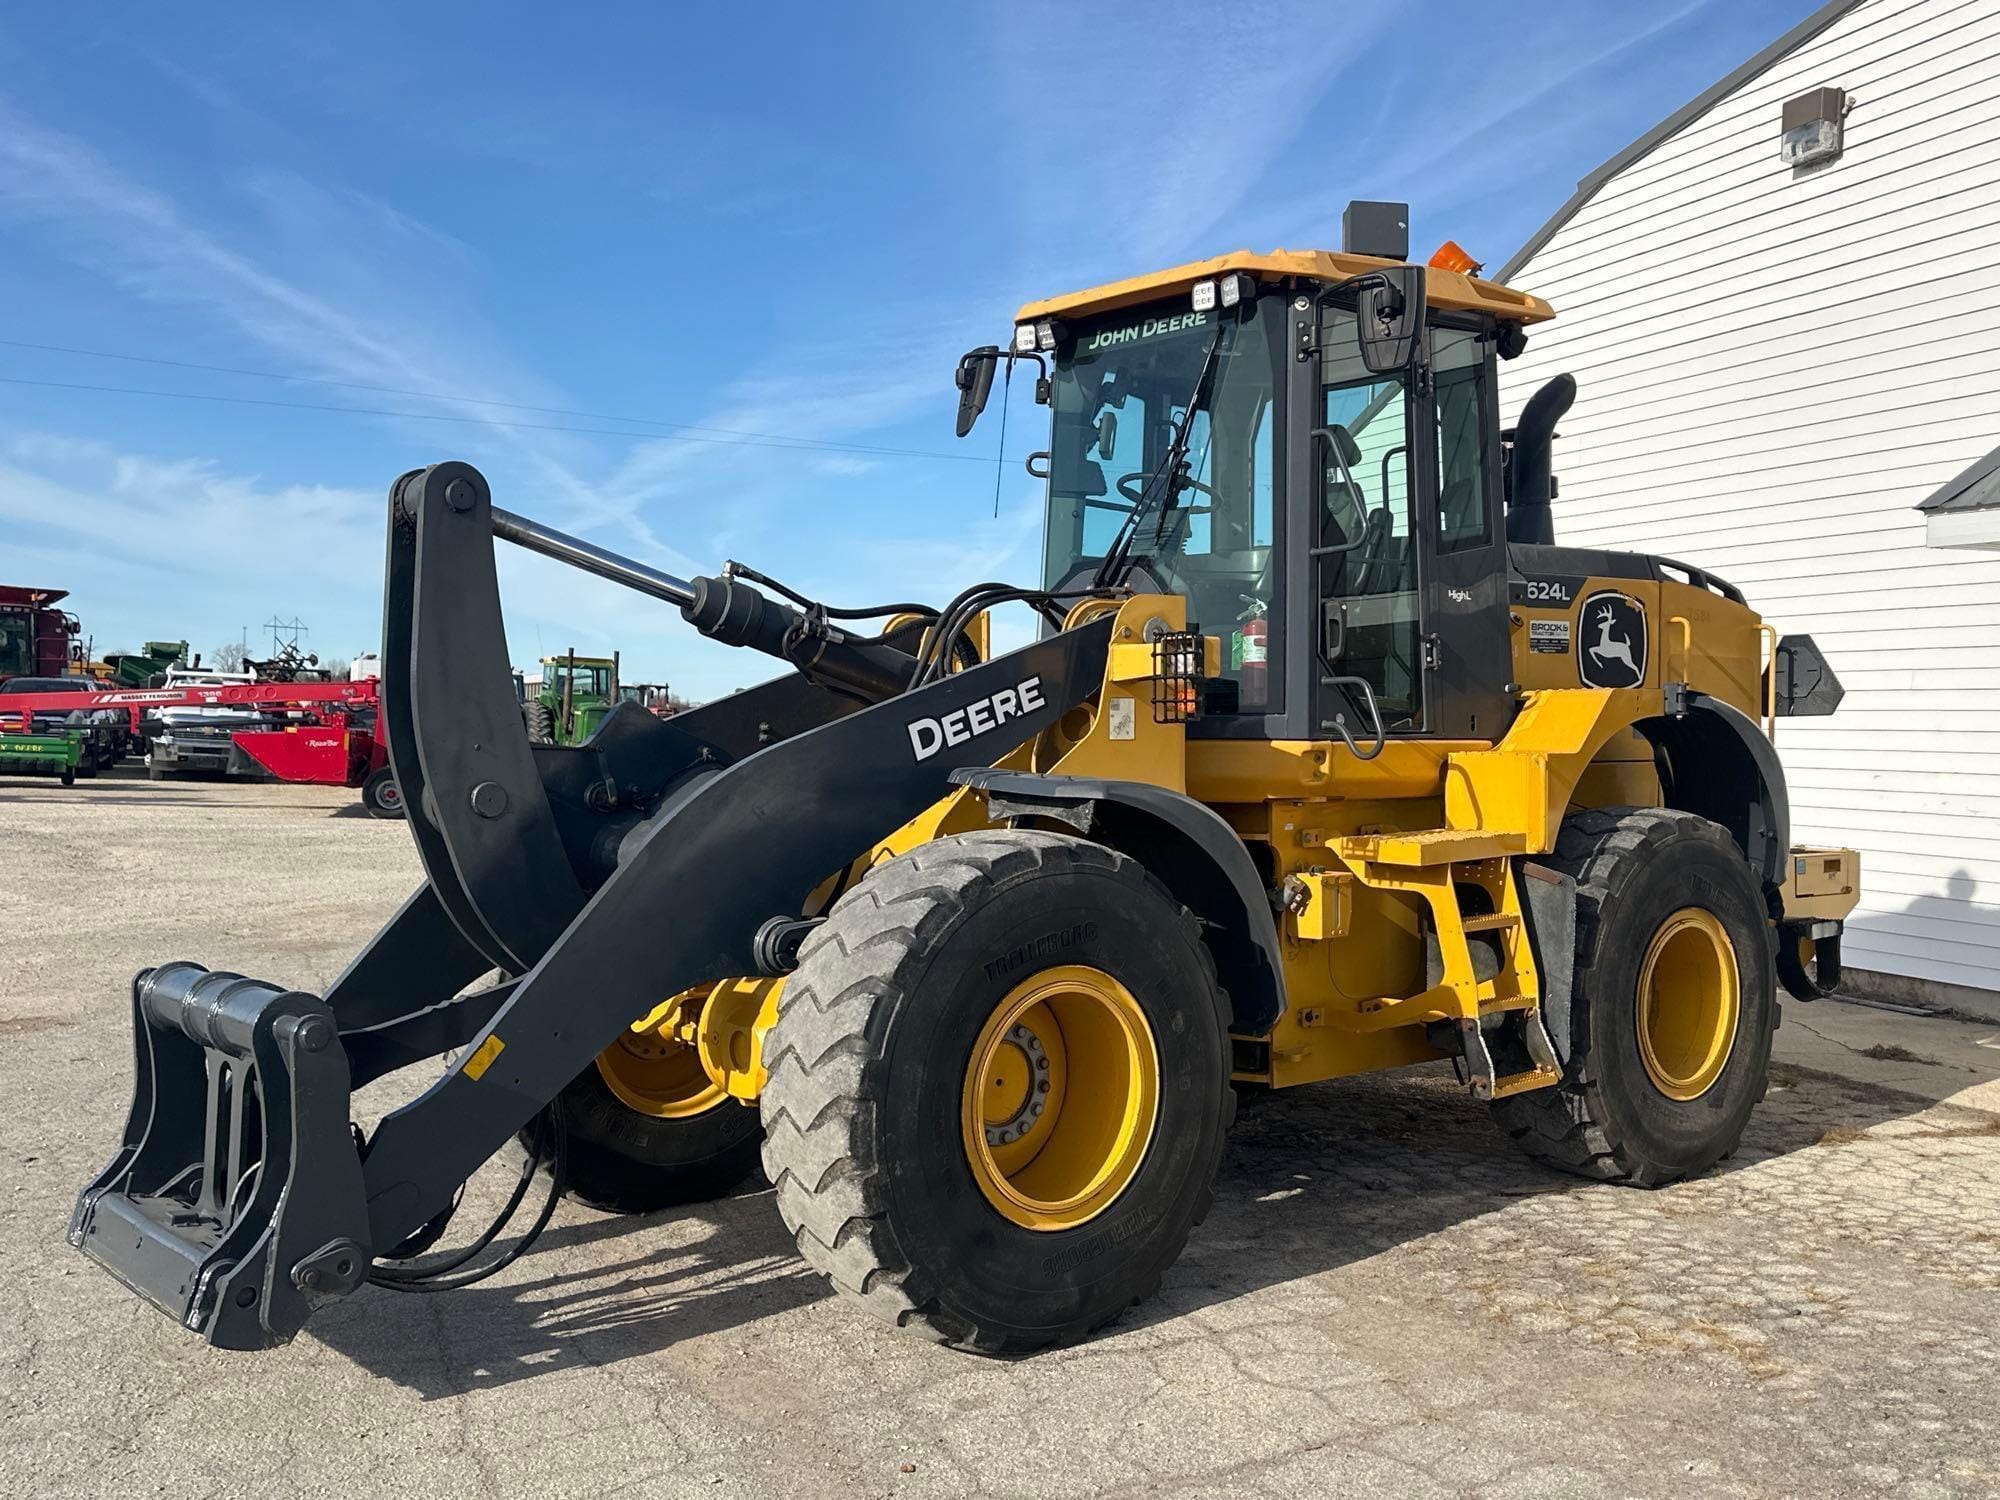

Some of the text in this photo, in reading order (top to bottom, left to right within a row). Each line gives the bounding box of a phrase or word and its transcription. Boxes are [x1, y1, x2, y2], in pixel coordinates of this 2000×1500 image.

[1088, 312, 1207, 350] JOHN DEERE
[1527, 581, 1571, 601] 624L
[1531, 622, 1569, 632] BROOKS
[149, 691, 183, 699] FERGUSON
[907, 676, 1046, 762] DEERE
[14, 744, 44, 752] DEERE
